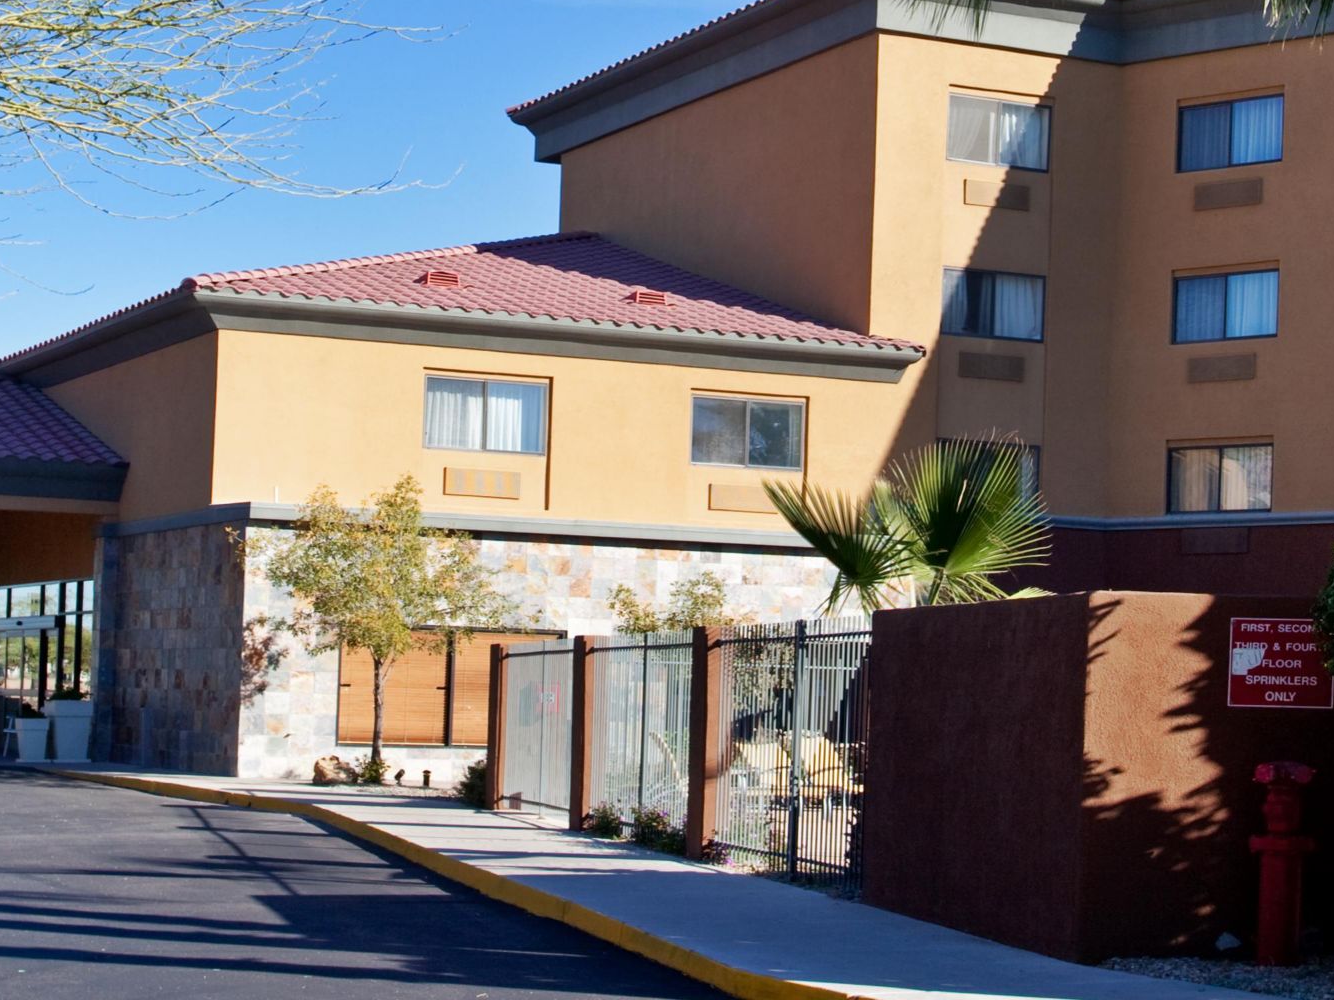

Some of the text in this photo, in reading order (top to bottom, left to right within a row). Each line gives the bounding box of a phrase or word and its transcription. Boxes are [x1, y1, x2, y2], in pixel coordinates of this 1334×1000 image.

[1241, 624, 1322, 634] FIRST, SECON
[1273, 643, 1281, 651] &
[1262, 659, 1302, 668] FLOOR
[1246, 675, 1318, 686] SPRINKLERS
[1265, 691, 1296, 702] ONLY
